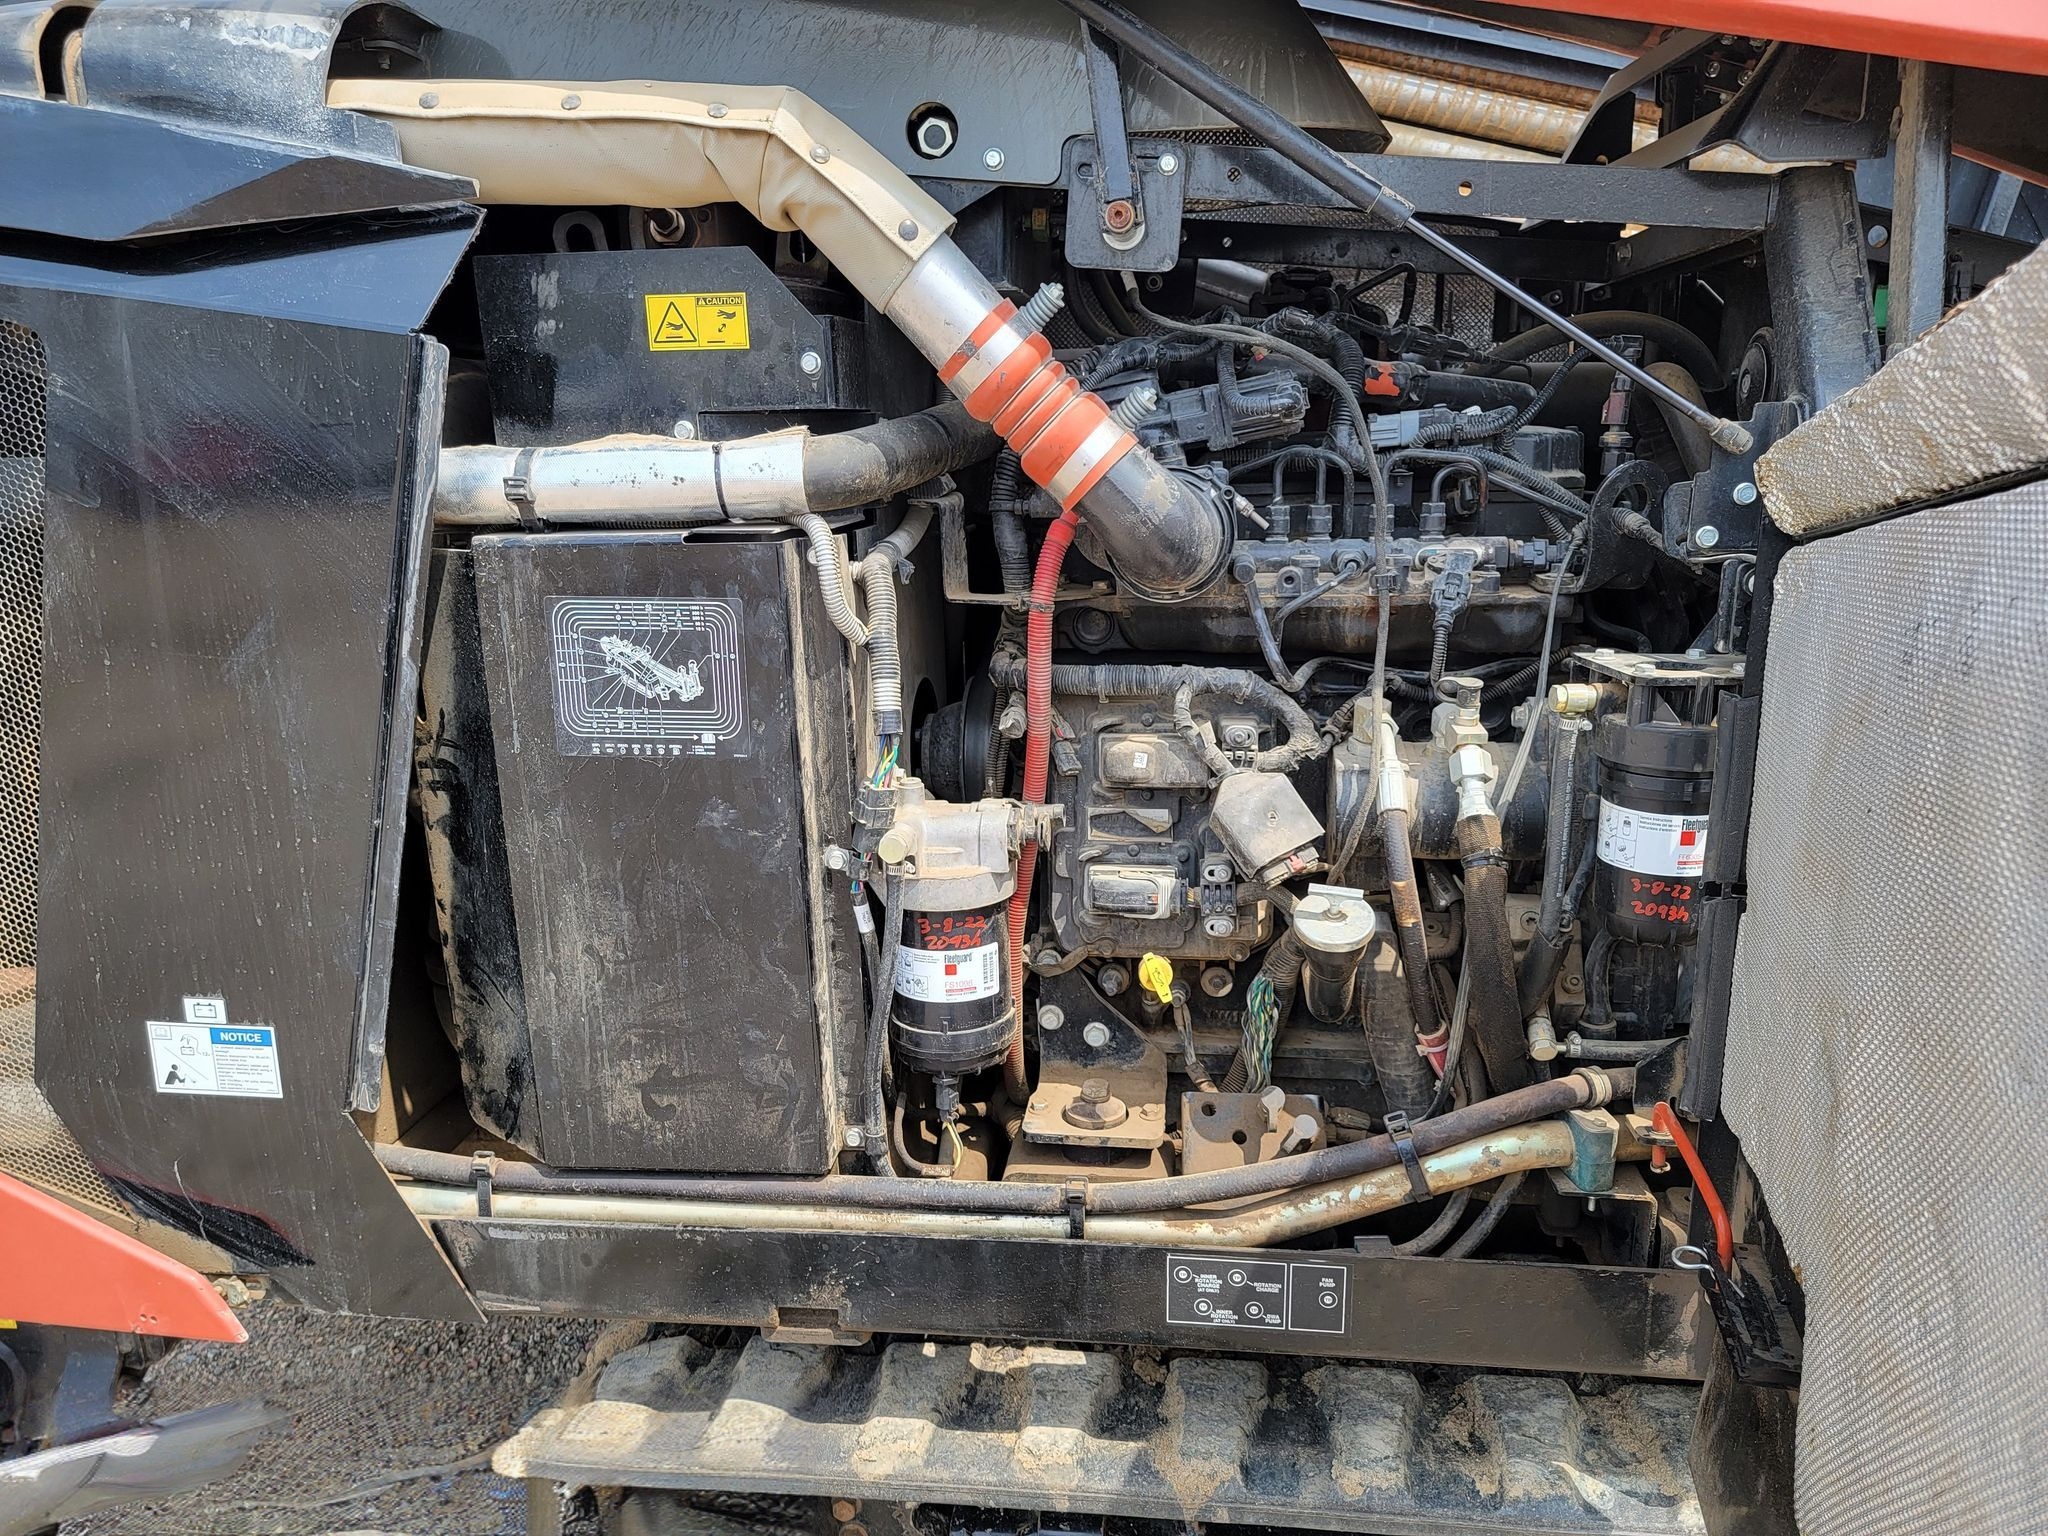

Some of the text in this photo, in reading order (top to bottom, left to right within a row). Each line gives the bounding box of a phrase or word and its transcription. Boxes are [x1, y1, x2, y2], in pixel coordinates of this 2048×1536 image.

[706, 297, 741, 305] CAUTION
[1631, 878, 1692, 900] 3-8-22
[917, 915, 987, 934] 3-8-22
[944, 952, 972, 965] Fleetguard
[219, 1031, 262, 1043] NOTICE
